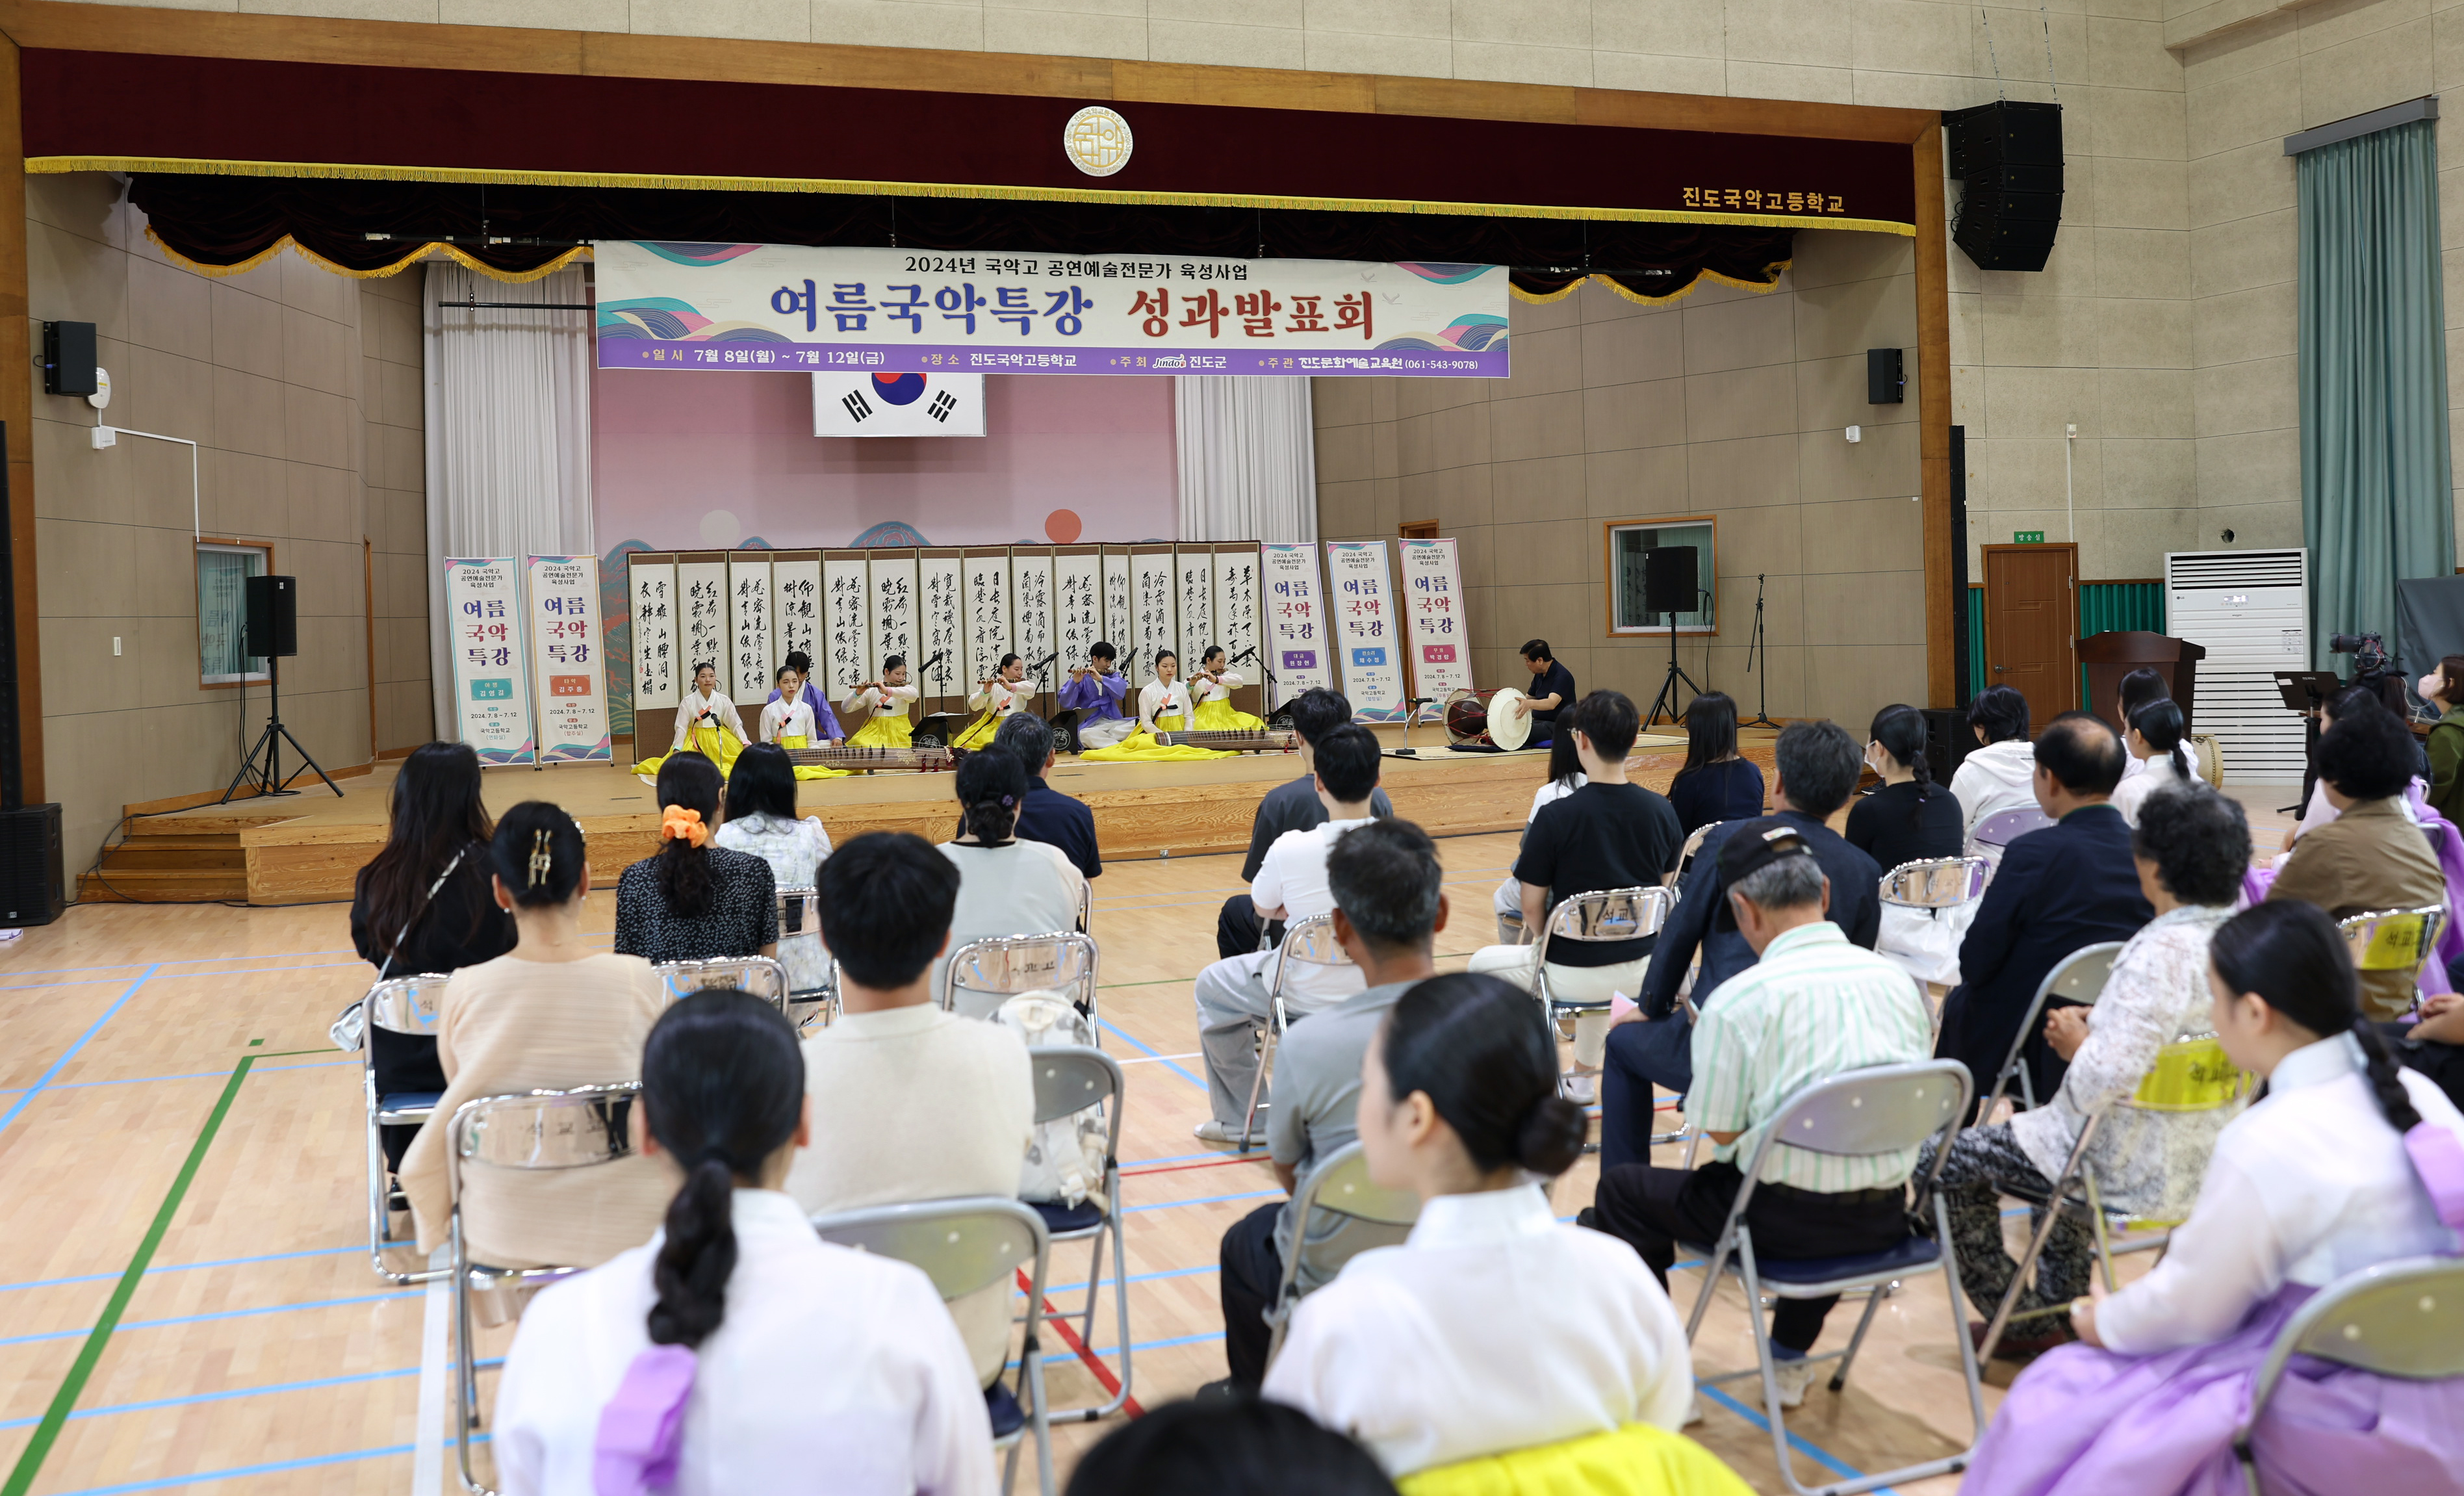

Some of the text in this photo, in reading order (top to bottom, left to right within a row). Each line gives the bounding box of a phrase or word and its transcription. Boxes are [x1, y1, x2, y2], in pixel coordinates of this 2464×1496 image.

[1079, 163, 1105, 175] CLASSICAL
[1107, 164, 1121, 174] MUSIC
[1120, 153, 1129, 164] HIGH
[1682, 187, 1845, 213] 진도국악고등학교
[905, 256, 1248, 281] 2024년 국악고 공연예술전문가 육성사업
[771, 277, 1372, 341] 여름국악특강 성과발표회
[694, 348, 719, 363] 7월
[724, 348, 776, 365] 8일(월)
[795, 350, 820, 364] 7월
[827, 350, 885, 366] 12일(금)
[970, 353, 1077, 368] 진도국악고등학교
[1190, 356, 1227, 369] 진도군
[1298, 356, 1404, 370] 진도문화예술교육원
[1405, 359, 1478, 370] (061-543-9078)
[1274, 580, 1309, 597] 여름
[1344, 579, 1378, 595] 여름
[1415, 576, 1448, 592] 여름
[463, 600, 506, 618] 여름
[545, 597, 585, 615] 여름
[1277, 601, 1312, 618] 국악
[1346, 599, 1381, 616] 국악
[1417, 596, 1451, 613] 국악
[465, 623, 508, 642] 국악
[546, 620, 588, 639] 국악
[1279, 623, 1315, 639] 특강
[1348, 620, 1384, 637] 특강
[1419, 617, 1454, 634] 특강
[467, 647, 511, 666] 특강
[548, 644, 590, 663] 특강
